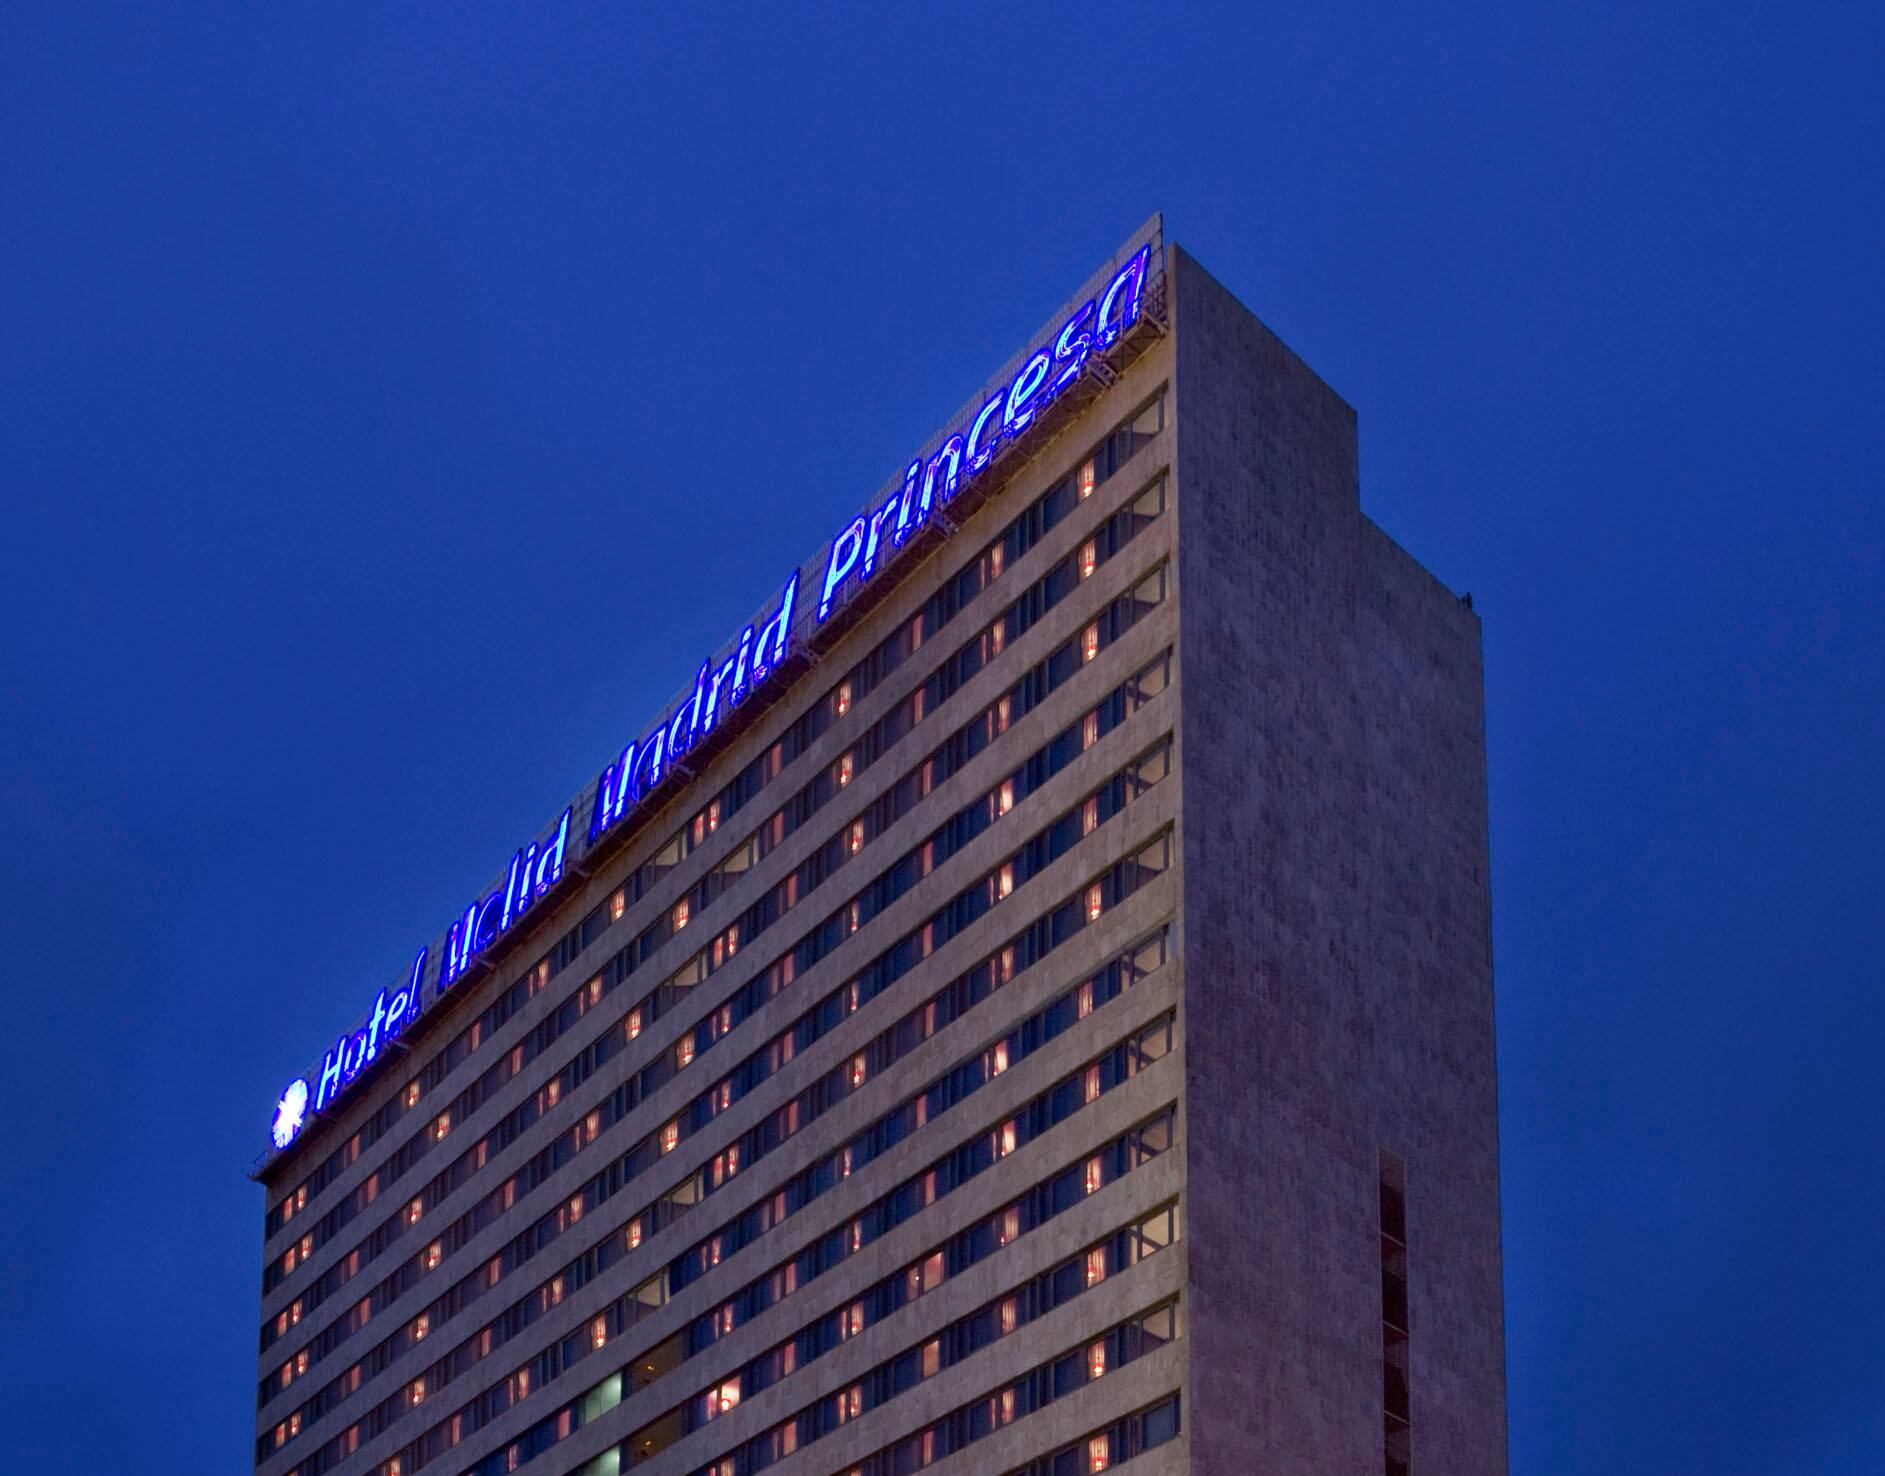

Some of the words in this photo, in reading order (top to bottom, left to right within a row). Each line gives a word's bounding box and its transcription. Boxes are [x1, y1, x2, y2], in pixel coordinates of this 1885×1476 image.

[313, 946, 428, 1112] Hotel
[588, 567, 799, 849] Madrid
[817, 244, 1151, 624] Princesa
